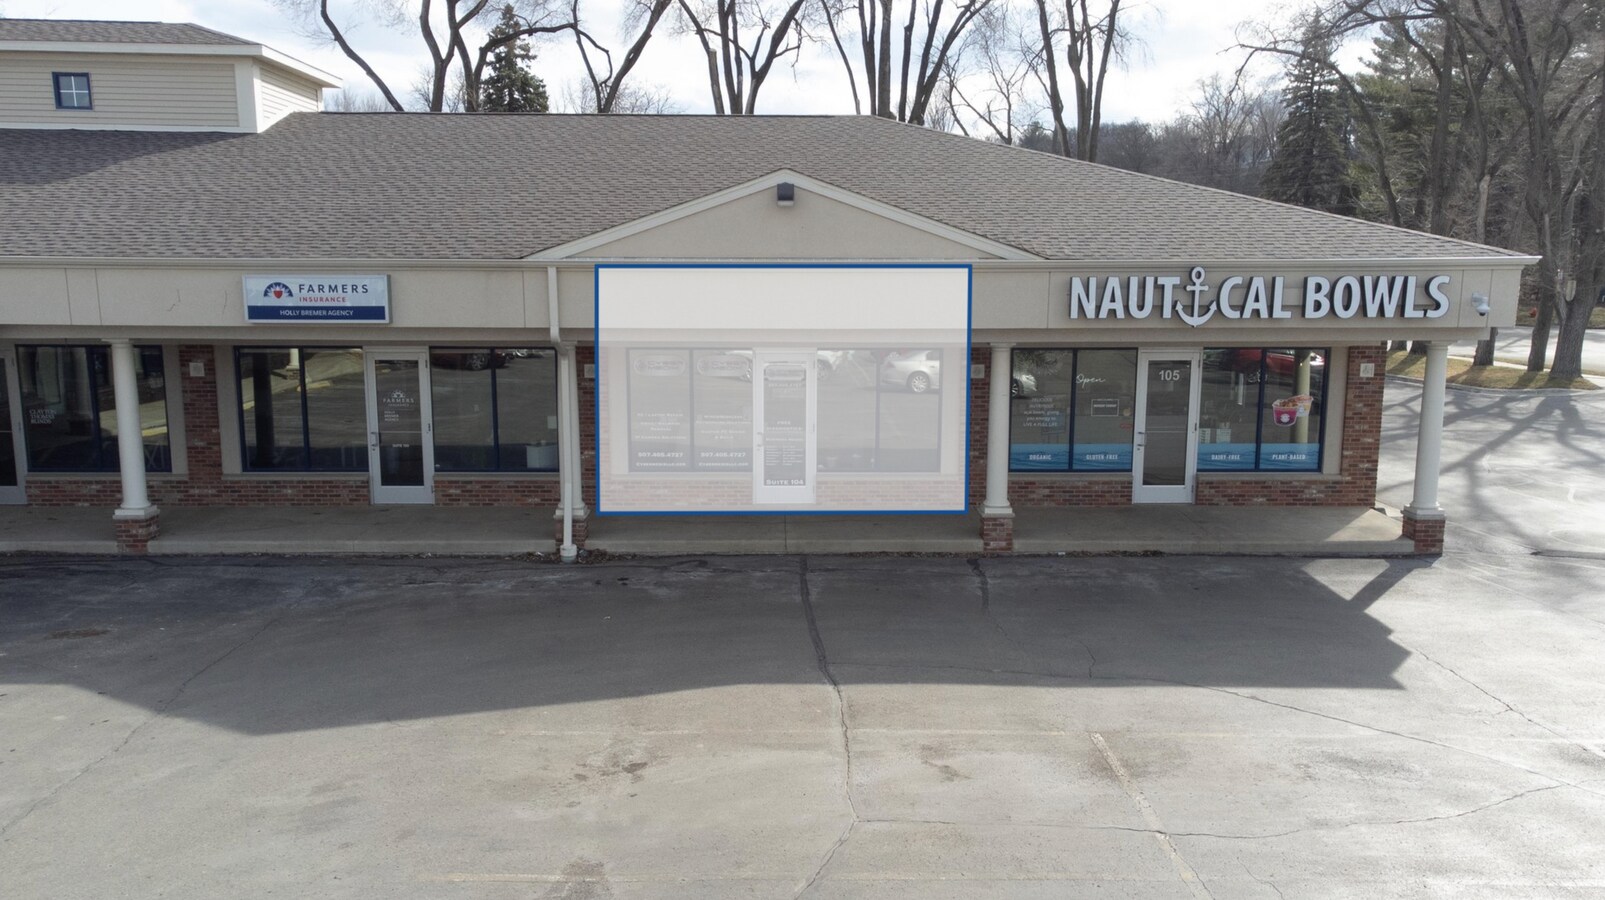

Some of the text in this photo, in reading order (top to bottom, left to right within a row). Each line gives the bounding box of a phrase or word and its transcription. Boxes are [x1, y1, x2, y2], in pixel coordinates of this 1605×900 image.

[298, 284, 369, 294] FARMERS
[1303, 275, 1451, 319] BOWLS
[1075, 373, 1106, 389] Open
[1158, 369, 1180, 381] 105
